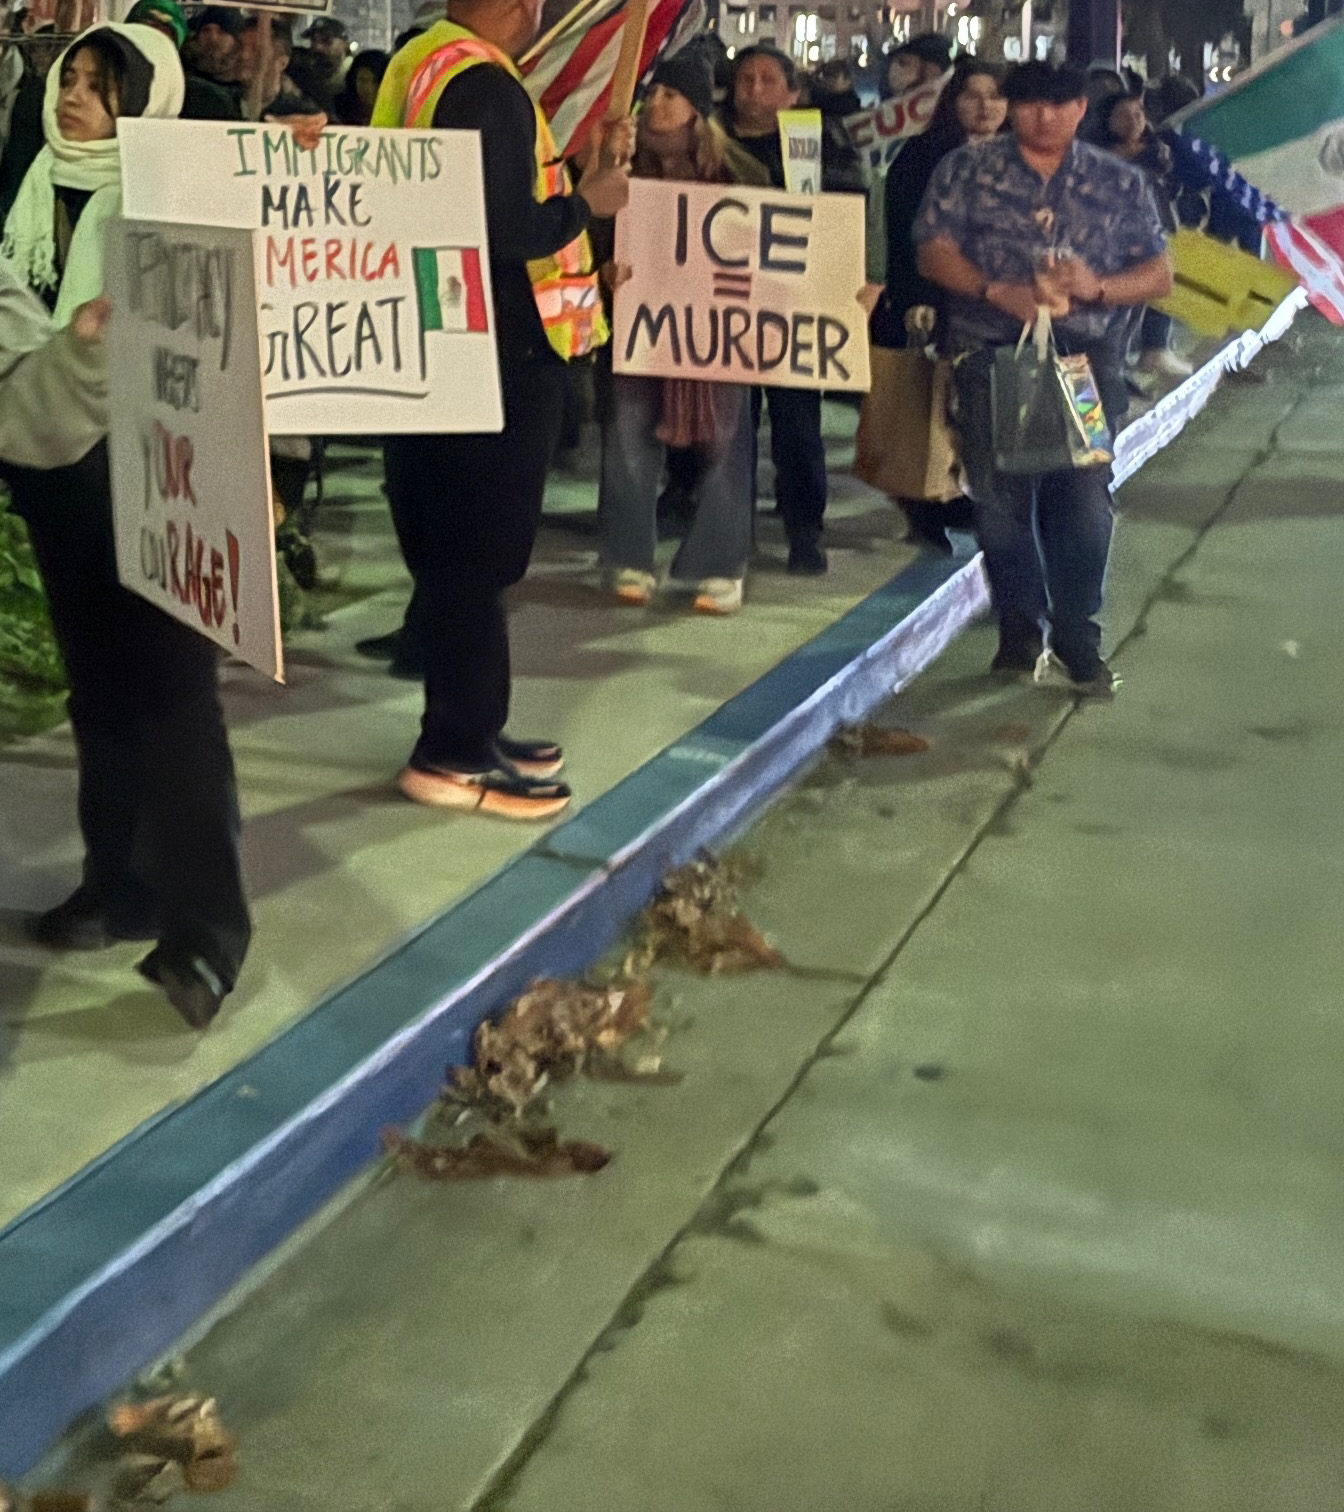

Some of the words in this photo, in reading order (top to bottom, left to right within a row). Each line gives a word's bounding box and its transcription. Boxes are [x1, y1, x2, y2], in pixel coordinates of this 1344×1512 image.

[226, 127, 443, 185] IMMIGRANTS
[261, 175, 372, 230] MAKE
[265, 234, 400, 289] MERICA
[675, 192, 814, 274] ICE
[624, 303, 851, 382] MURDER
